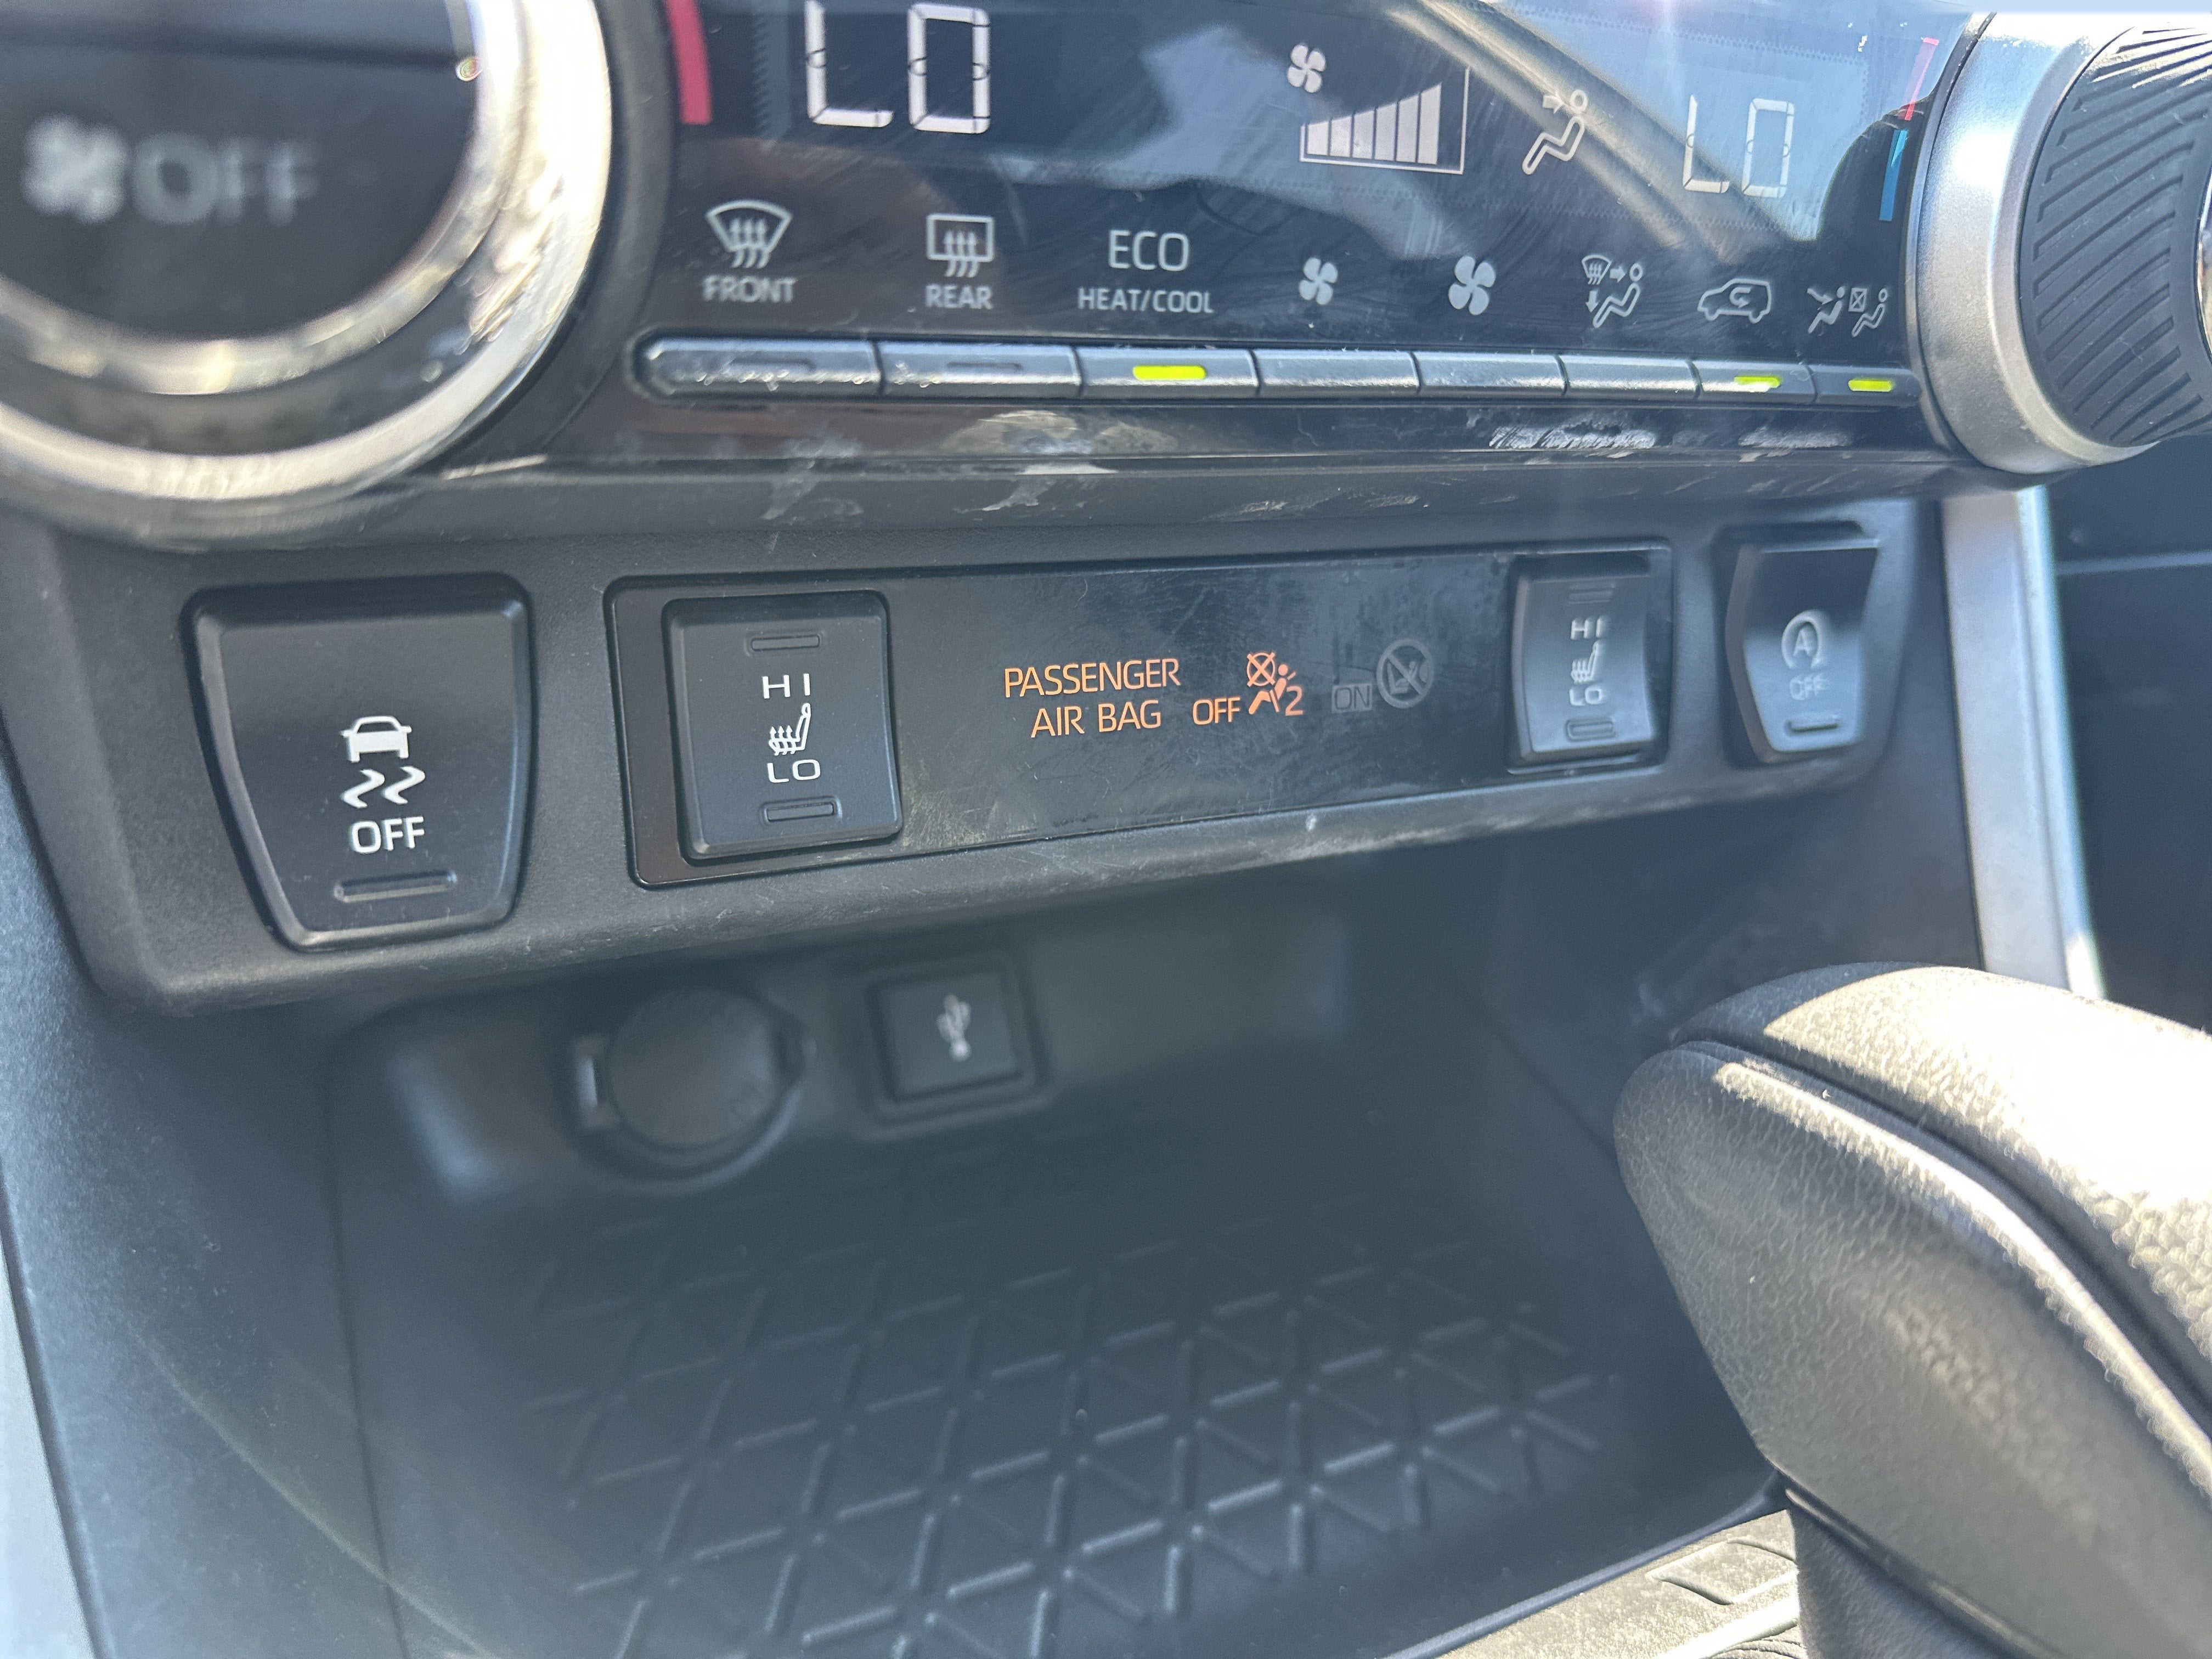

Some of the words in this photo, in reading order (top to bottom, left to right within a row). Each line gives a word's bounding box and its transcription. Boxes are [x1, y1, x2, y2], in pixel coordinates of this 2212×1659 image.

[805, 0, 990, 134] LO
[1683, 94, 1795, 198] LO
[131, 131, 319, 224] OFF
[1109, 229, 1189, 272] ECO
[703, 275, 798, 303] FRONT
[925, 284, 994, 309] REAR
[1077, 287, 1213, 314] HEAT/COOL
[1570, 616, 1605, 640] HI
[762, 673, 811, 699] HI
[1005, 658, 1181, 698] PASSENGER
[1333, 687, 1373, 711] ON
[1568, 685, 1604, 706] LO
[1031, 708, 1085, 738] AIR
[1097, 699, 1162, 733] BAG
[1192, 696, 1240, 725] OFF
[767, 759, 821, 783] LO
[349, 816, 425, 853] OFF
